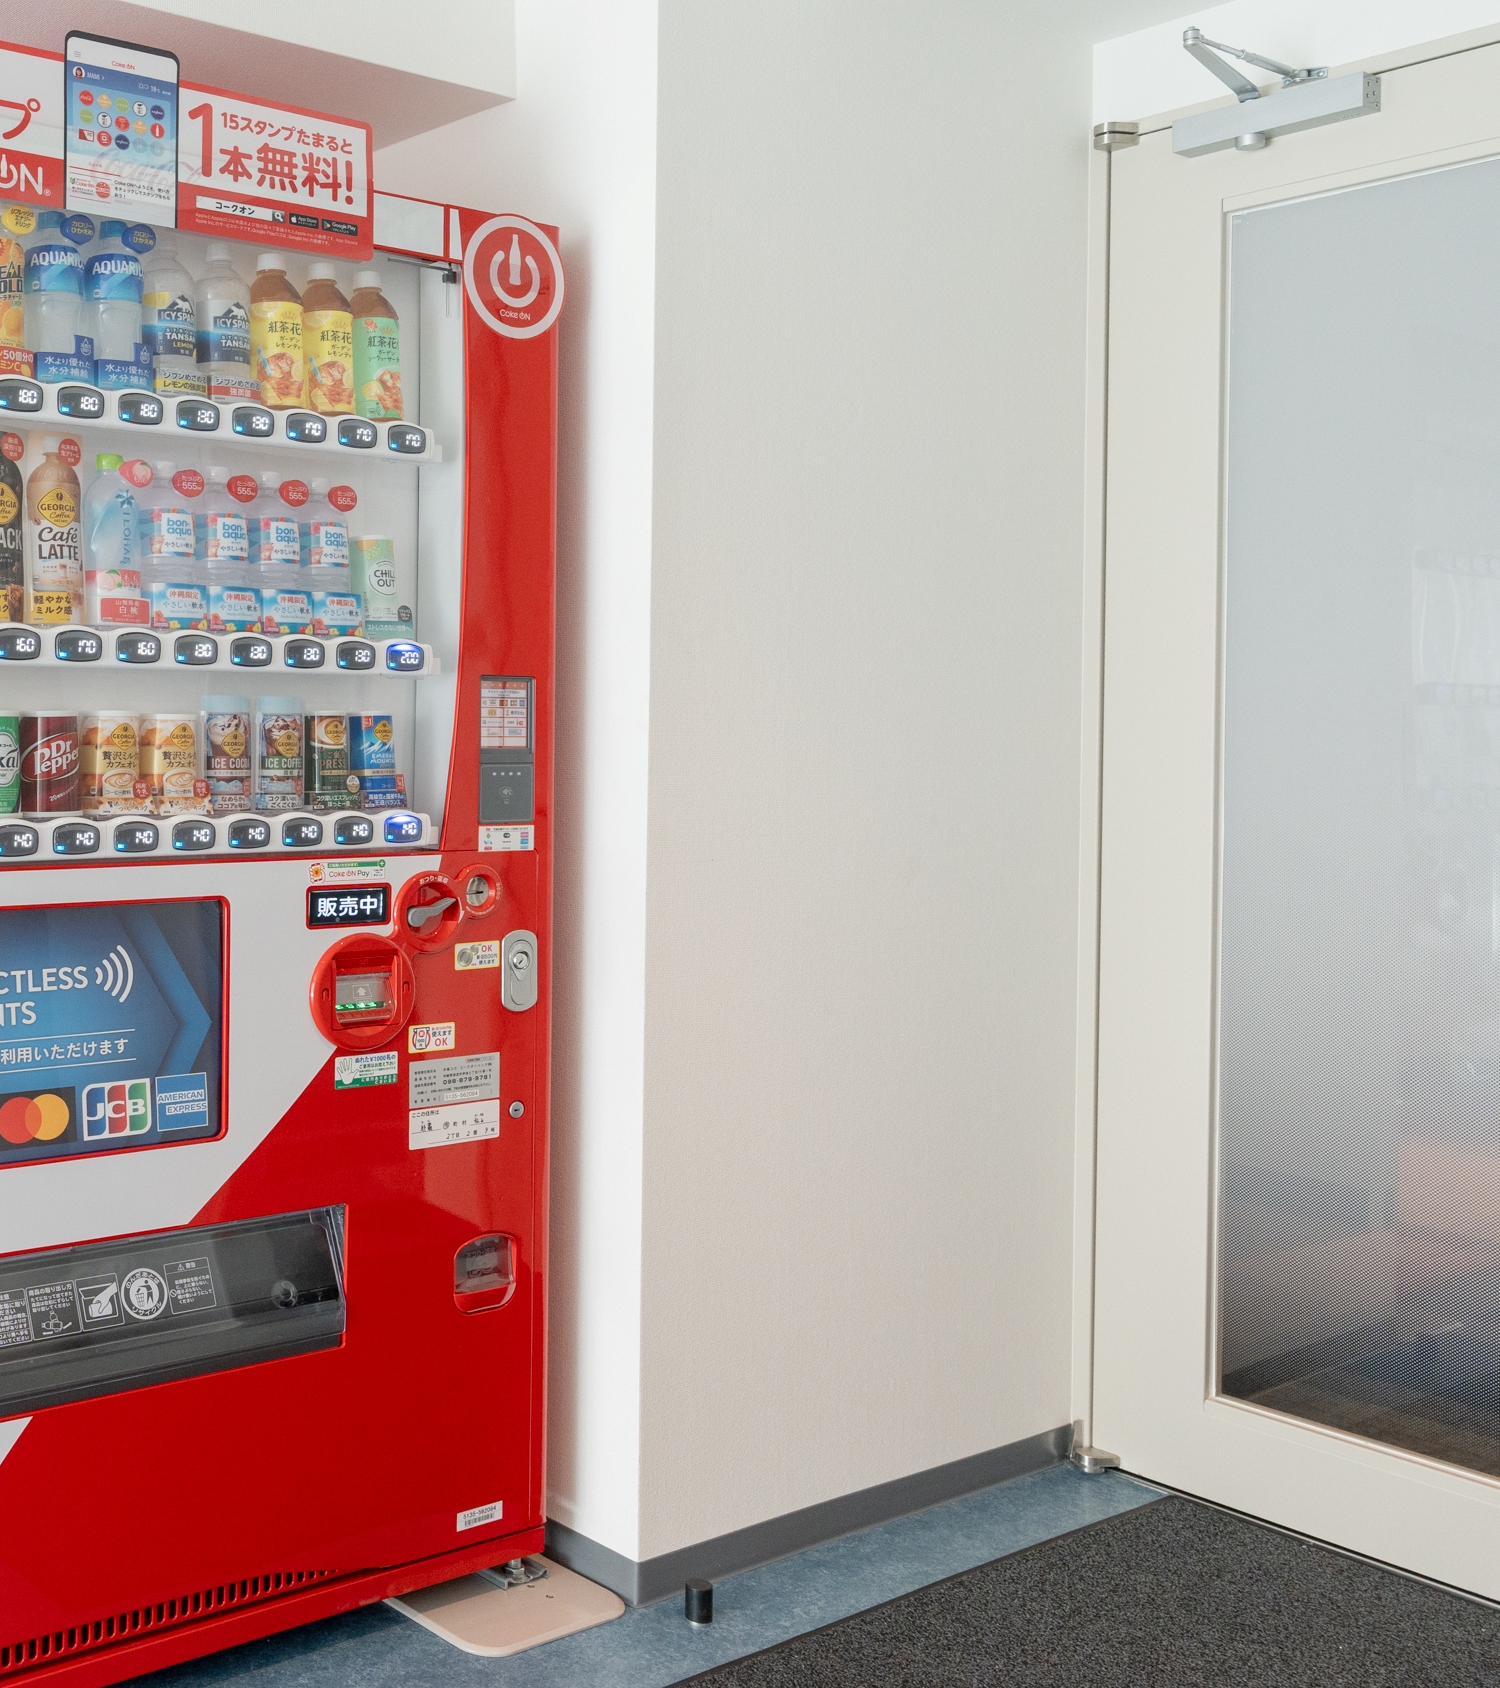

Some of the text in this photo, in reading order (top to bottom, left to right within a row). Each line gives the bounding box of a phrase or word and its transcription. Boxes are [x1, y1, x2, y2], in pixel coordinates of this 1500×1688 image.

[221, 112, 353, 155] 15スタンプたまると
[215, 201, 255, 215] コークオン
[30, 250, 85, 270] AQUARIU
[92, 260, 145, 279] AQUARIU
[500, 308, 518, 319] Coke
[268, 321, 303, 337] 紅茶花
[320, 329, 352, 345] 紅茶花
[367, 335, 399, 350] 紅茶花
[173, 341, 194, 350] LEMON
[44, 355, 91, 369] 水より優れた
[48, 366, 89, 379] 水分補給
[105, 363, 150, 377] 水より優れた
[108, 374, 147, 387] 水分補給
[18, 388, 37, 404] 180
[80, 396, 99, 411] 180
[140, 403, 157, 417] 180
[197, 410, 214, 424] 130
[252, 416, 269, 430] 130
[40, 503, 76, 514] GEORGIA
[49, 511, 71, 520] Coffee
[38, 526, 78, 544] Café
[167, 526, 192, 538] aqua
[222, 530, 246, 541] aqua
[276, 534, 298, 545] aqua
[325, 539, 347, 549] aqua
[38, 544, 79, 562] LATTE
[377, 578, 396, 588] OUT
[34, 594, 72, 605] 軽やかな
[169, 590, 199, 600] 沖縄限定
[226, 593, 253, 602] 沖縄限定
[280, 596, 306, 605] 沖縄限定
[162, 600, 204, 610] やさしい軟水
[219, 603, 258, 613] やさしい軟水
[329, 598, 355, 608] 沖縄限定
[35, 605, 73, 615] ミルク感
[274, 606, 310, 615] やさしい軟水
[323, 609, 359, 618] やさしい軟水
[366, 624, 411, 632] ストレスのない世界へ
[16, 638, 34, 652] 160
[138, 642, 155, 656] 160
[195, 644, 212, 657] 130
[250, 646, 267, 659] 130
[303, 647, 319, 661] 130
[354, 649, 370, 662] 130
[400, 651, 419, 664] 200
[51, 738, 73, 753] Dr
[211, 758, 227, 769] ICE
[265, 758, 280, 769] ICE
[193, 829, 210, 842] 140
[248, 827, 265, 840] 140
[301, 826, 318, 839] 140
[352, 825, 369, 837] 140
[402, 823, 417, 836] 140
[14, 833, 33, 848] 140
[76, 832, 94, 845] 140
[135, 830, 153, 844] 140
[328, 870, 346, 878] Coke
[357, 869, 370, 878] Pay
[317, 894, 378, 917] 販売中
[481, 944, 493, 952] OK
[478, 958, 495, 966] 使えます
[432, 1029, 452, 1037] 使えます
[434, 1037, 448, 1047] OK
[157, 1091, 203, 1103] AMERICAN
[86, 1098, 147, 1121] JCB
[167, 1102, 207, 1114] EXPRESS
[411, 1109, 440, 1118] ここの住所は
[28, 1283, 73, 1296] 商品の取り出し方
[132, 1300, 162, 1316] リサイクル
